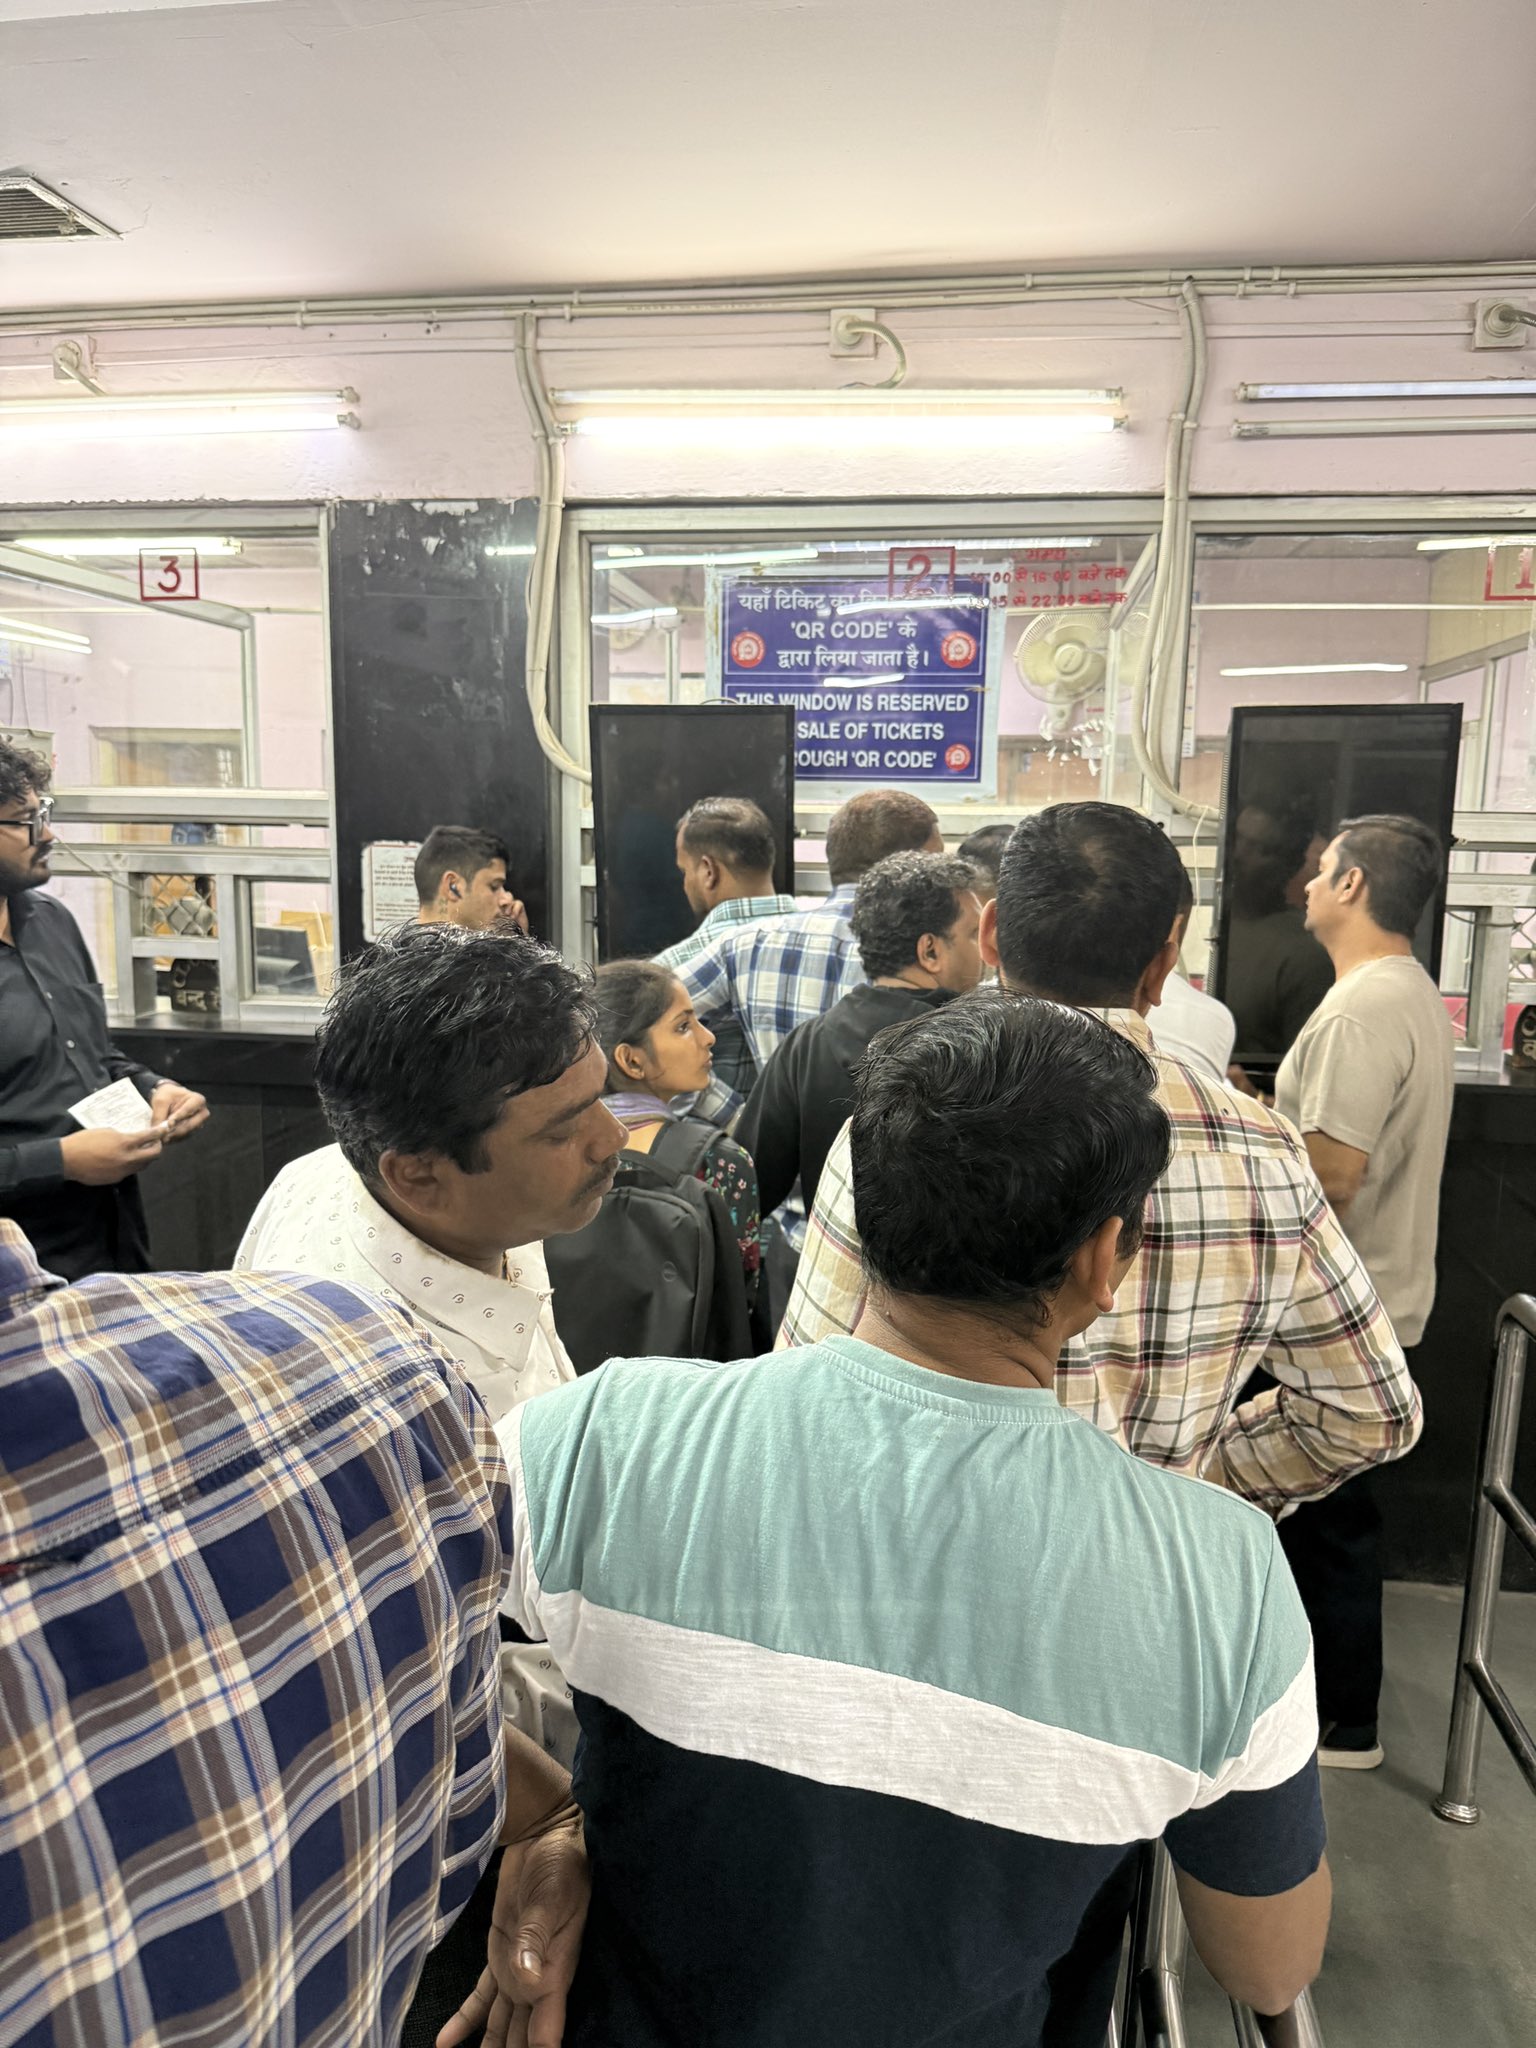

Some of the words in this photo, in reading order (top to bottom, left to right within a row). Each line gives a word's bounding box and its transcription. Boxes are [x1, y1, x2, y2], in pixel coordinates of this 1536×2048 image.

[157, 554, 181, 593] 3
[907, 554, 932, 597] 2
[1515, 547, 1535, 590] 1
[737, 586, 772, 612] यहाँ
[791, 621, 825, 640] 'QR
[830, 621, 894, 639] CODE'
[897, 616, 917, 637] के
[776, 650, 811, 668] द्वारा
[814, 645, 858, 667] लिया
[860, 650, 903, 667] जाता
[735, 692, 775, 705] THIS
[778, 693, 853, 711] WINDOW
[857, 694, 874, 711] IS
[877, 694, 969, 712] RESERVED
[797, 722, 840, 740] SALE
[844, 722, 869, 740] OF
[871, 722, 945, 741] TICKETS
[851, 751, 881, 768] 'QR
[884, 751, 937, 769] CODE'
